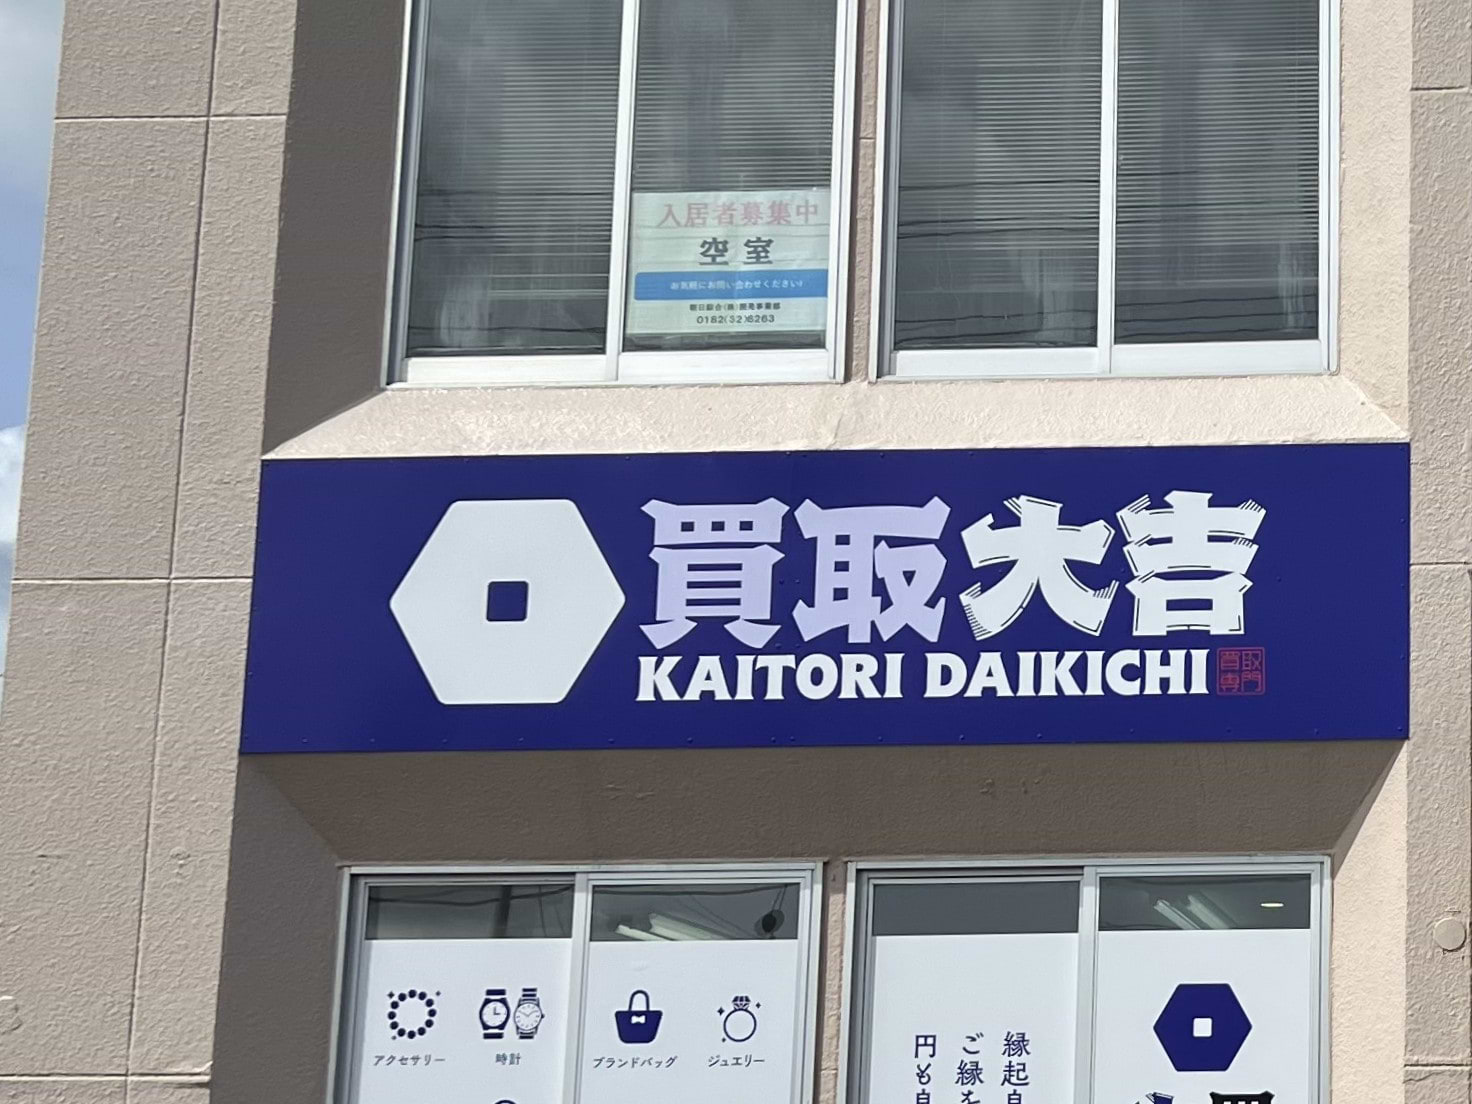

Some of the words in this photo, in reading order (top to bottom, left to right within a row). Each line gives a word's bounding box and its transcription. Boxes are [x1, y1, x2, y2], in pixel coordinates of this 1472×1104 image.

[657, 199, 819, 228] 入居者募集中
[639, 490, 1267, 650] 買取大吉
[635, 653, 905, 702] KAITORI
[923, 649, 1210, 698] DAIKICHI
[372, 1054, 446, 1067] アクセサリー
[495, 1052, 521, 1066] 時計
[592, 1055, 678, 1069] ブランドバッグ
[707, 1055, 765, 1068] ジュエリー
